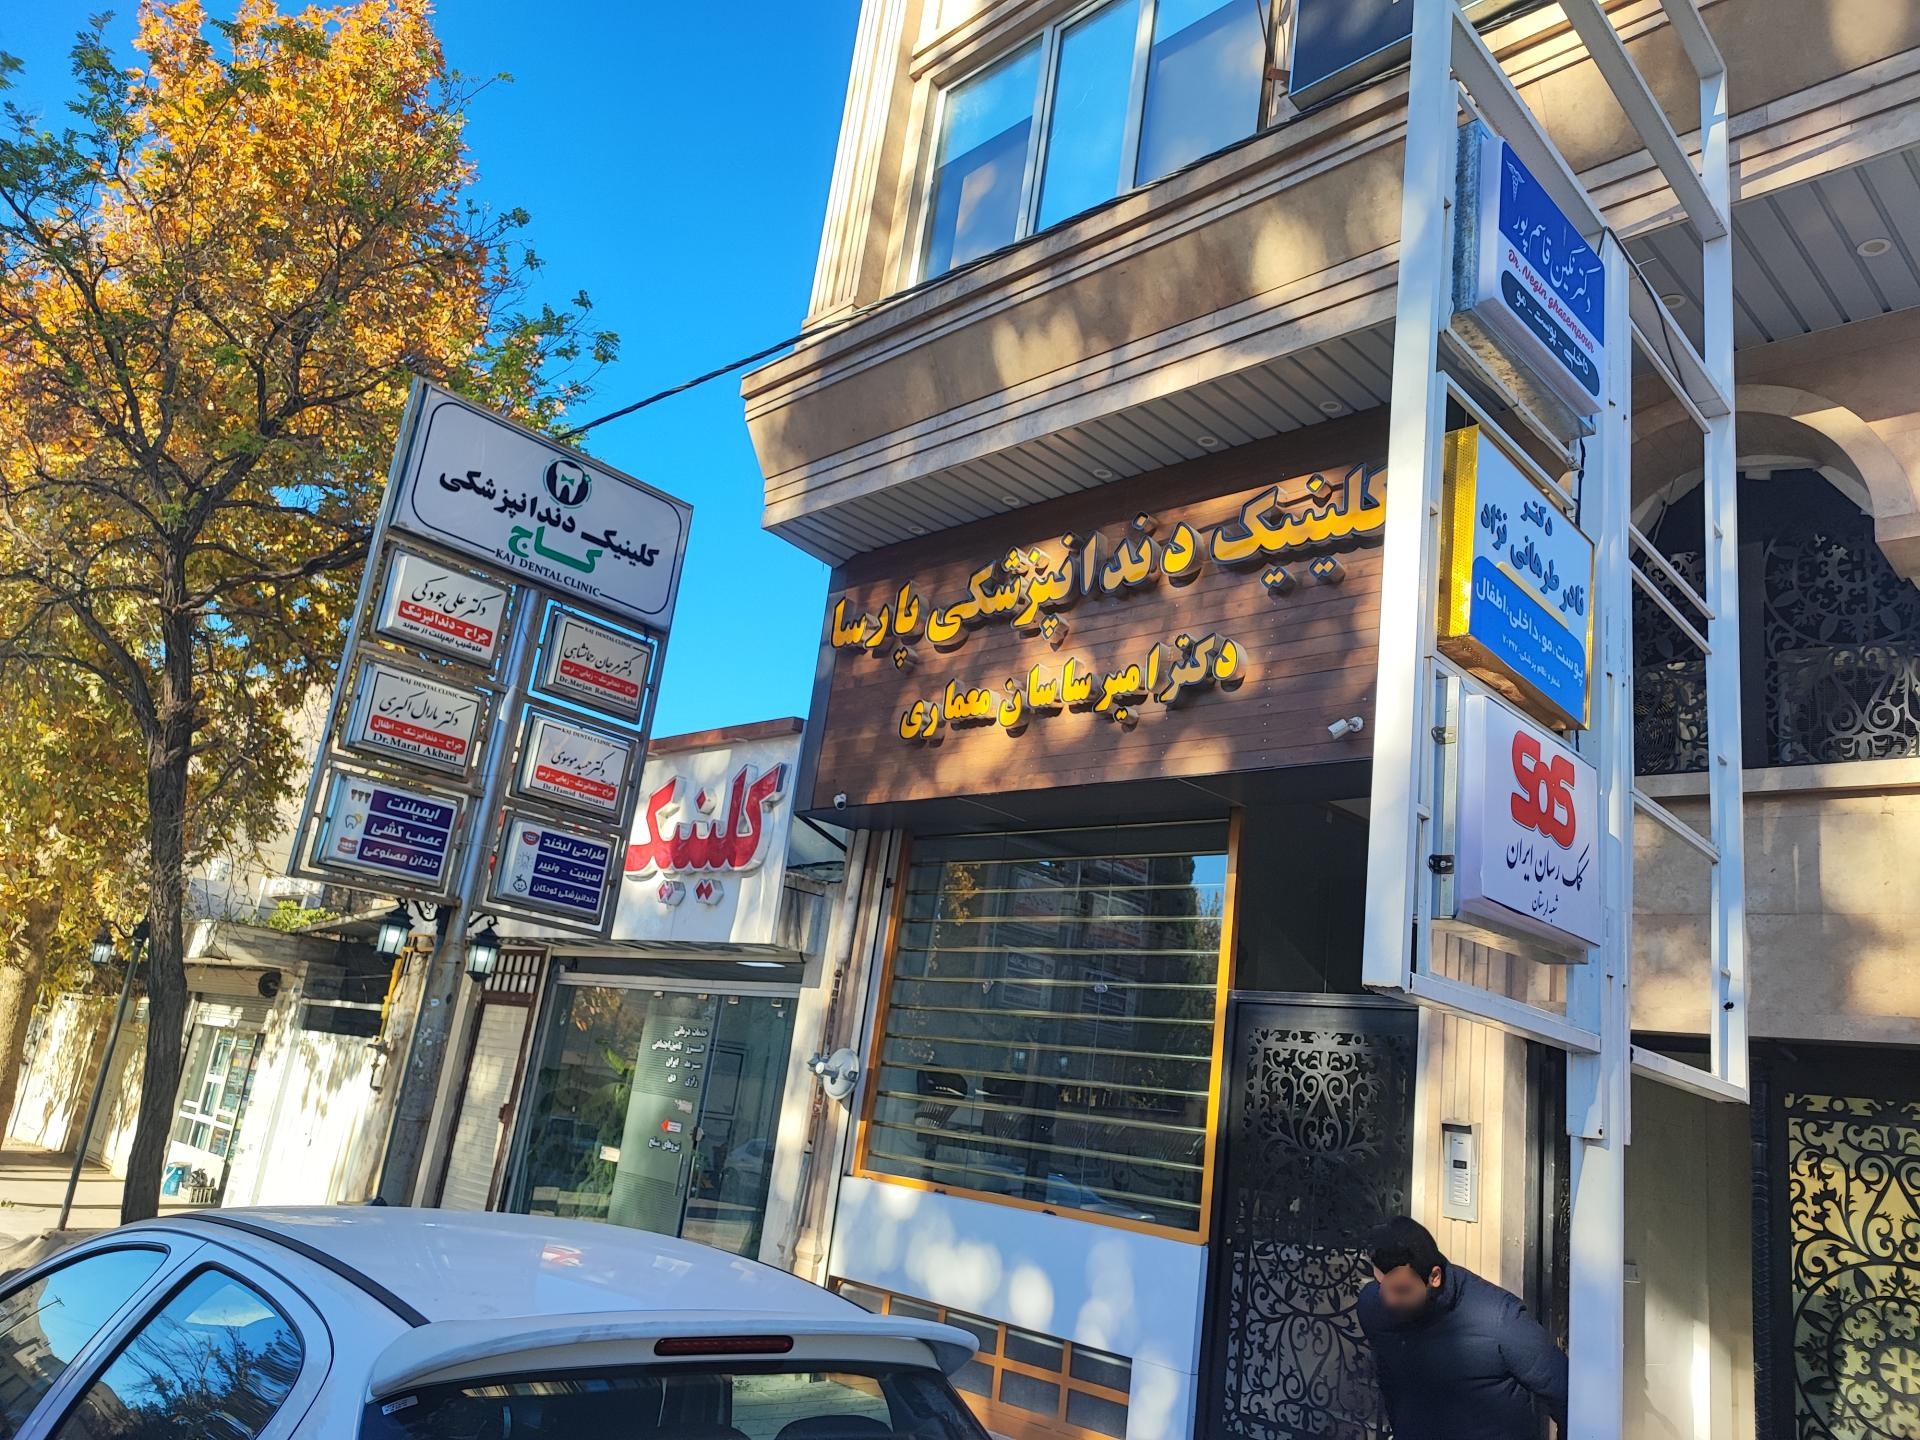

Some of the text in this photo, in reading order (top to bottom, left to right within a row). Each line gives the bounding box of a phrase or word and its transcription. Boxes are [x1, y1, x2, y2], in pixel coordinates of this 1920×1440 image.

[1513, 215, 1601, 313] دکتر نگین قاسم پور
[1522, 265, 1548, 301] Negin
[439, 470, 660, 567] کلینیک دندانپزشکی
[1520, 500, 1553, 537] دکتر
[508, 525, 603, 574] کاج
[831, 463, 1388, 670] کلینیک دندانپزشکی پارسا
[1481, 503, 1584, 616] نادر طرهانی نژاد
[494, 548, 600, 597] KAJ DENTAL CLINIC
[443, 592, 466, 614] علی
[458, 593, 502, 618] دکتر
[401, 604, 489, 644] جراح دندانپزشک
[400, 675, 460, 699] KAJ DENTAL CLINIC
[899, 631, 1240, 740] دکتر امیر ساسان معماری
[379, 690, 472, 729] دکتر مارال اکبری
[372, 733, 457, 762] Dr.Maral Akbari
[445, 740, 463, 751] جراح
[551, 751, 578, 767] موسوی
[585, 751, 616, 776] دکتر
[1510, 730, 1576, 850] SOS
[386, 798, 441, 823] ایمپلنت
[370, 821, 443, 847] عصب کشی
[543, 838, 606, 860] طراحی لبخند
[625, 763, 785, 906] کلینیک
[363, 846, 439, 869] دندان مصنوعی
[1506, 837, 1533, 882] ایران
[1535, 850, 1560, 883] رسان
[533, 883, 597, 904] دندانپزشکی کودکان
